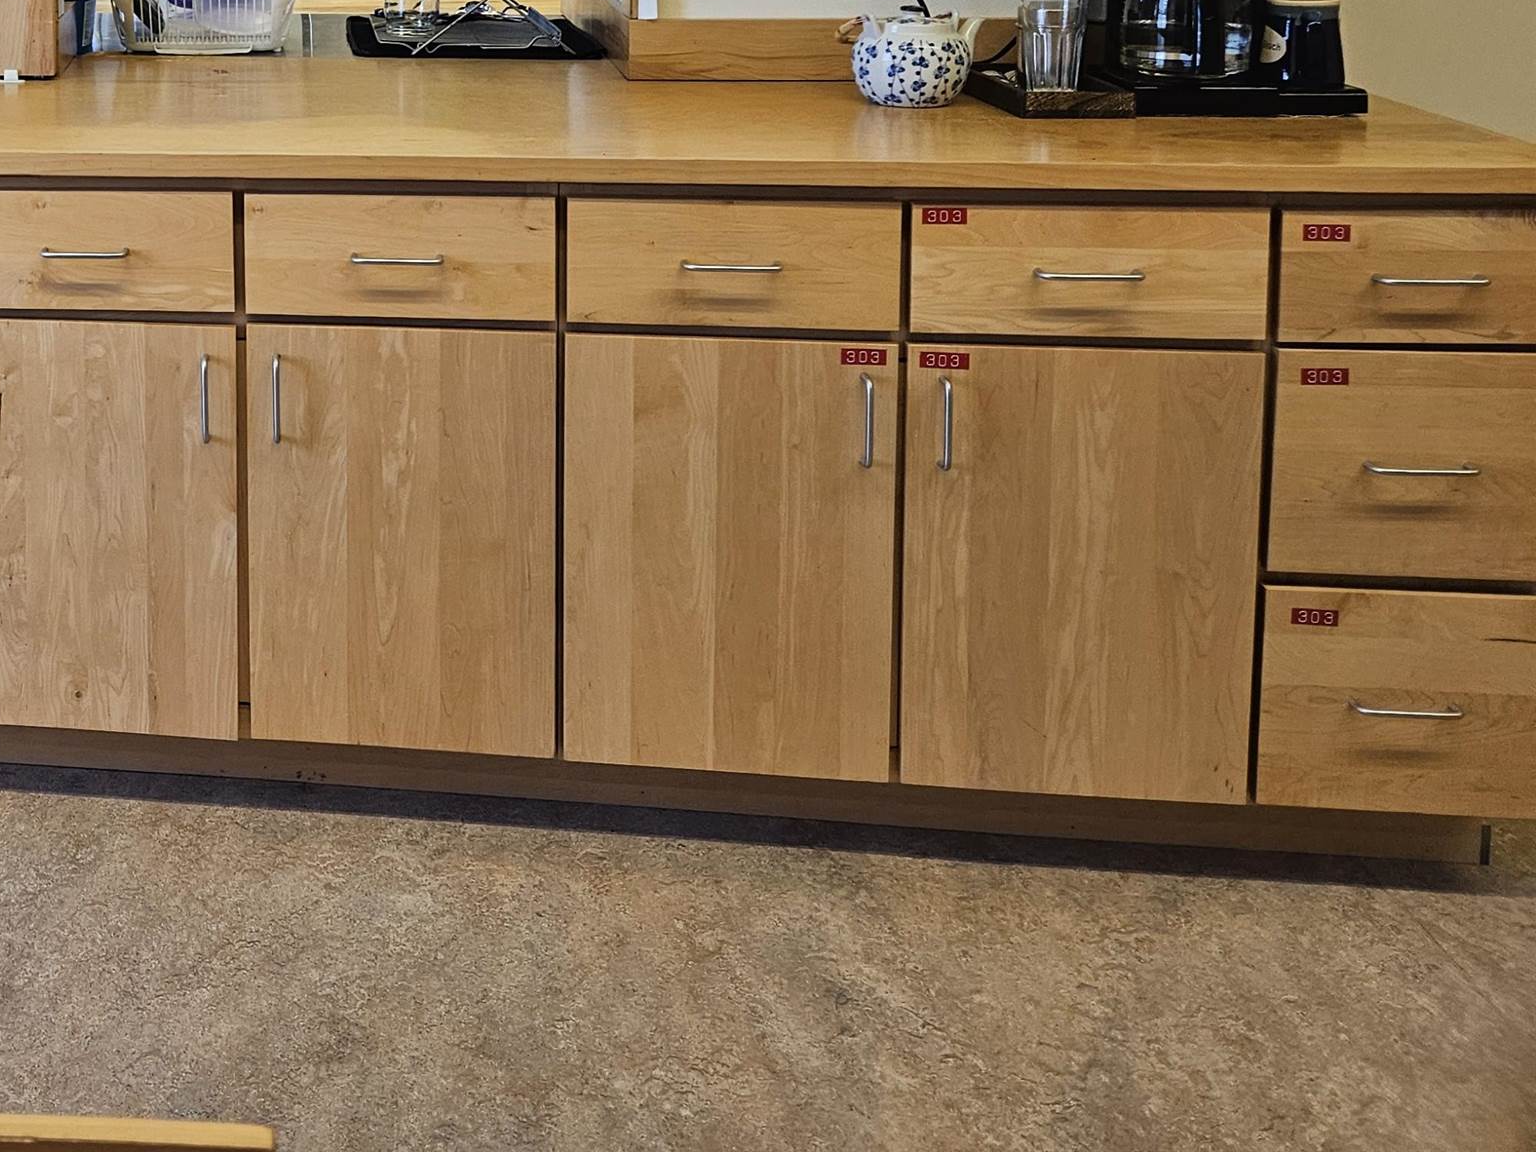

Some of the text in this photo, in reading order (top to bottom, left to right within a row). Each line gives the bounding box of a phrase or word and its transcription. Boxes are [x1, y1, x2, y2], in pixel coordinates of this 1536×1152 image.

[927, 209, 962, 223] 303
[1307, 226, 1345, 240] 303
[846, 350, 880, 364] 303
[926, 353, 960, 368] 303
[1307, 370, 1343, 384] 303
[1297, 610, 1334, 625] 303
